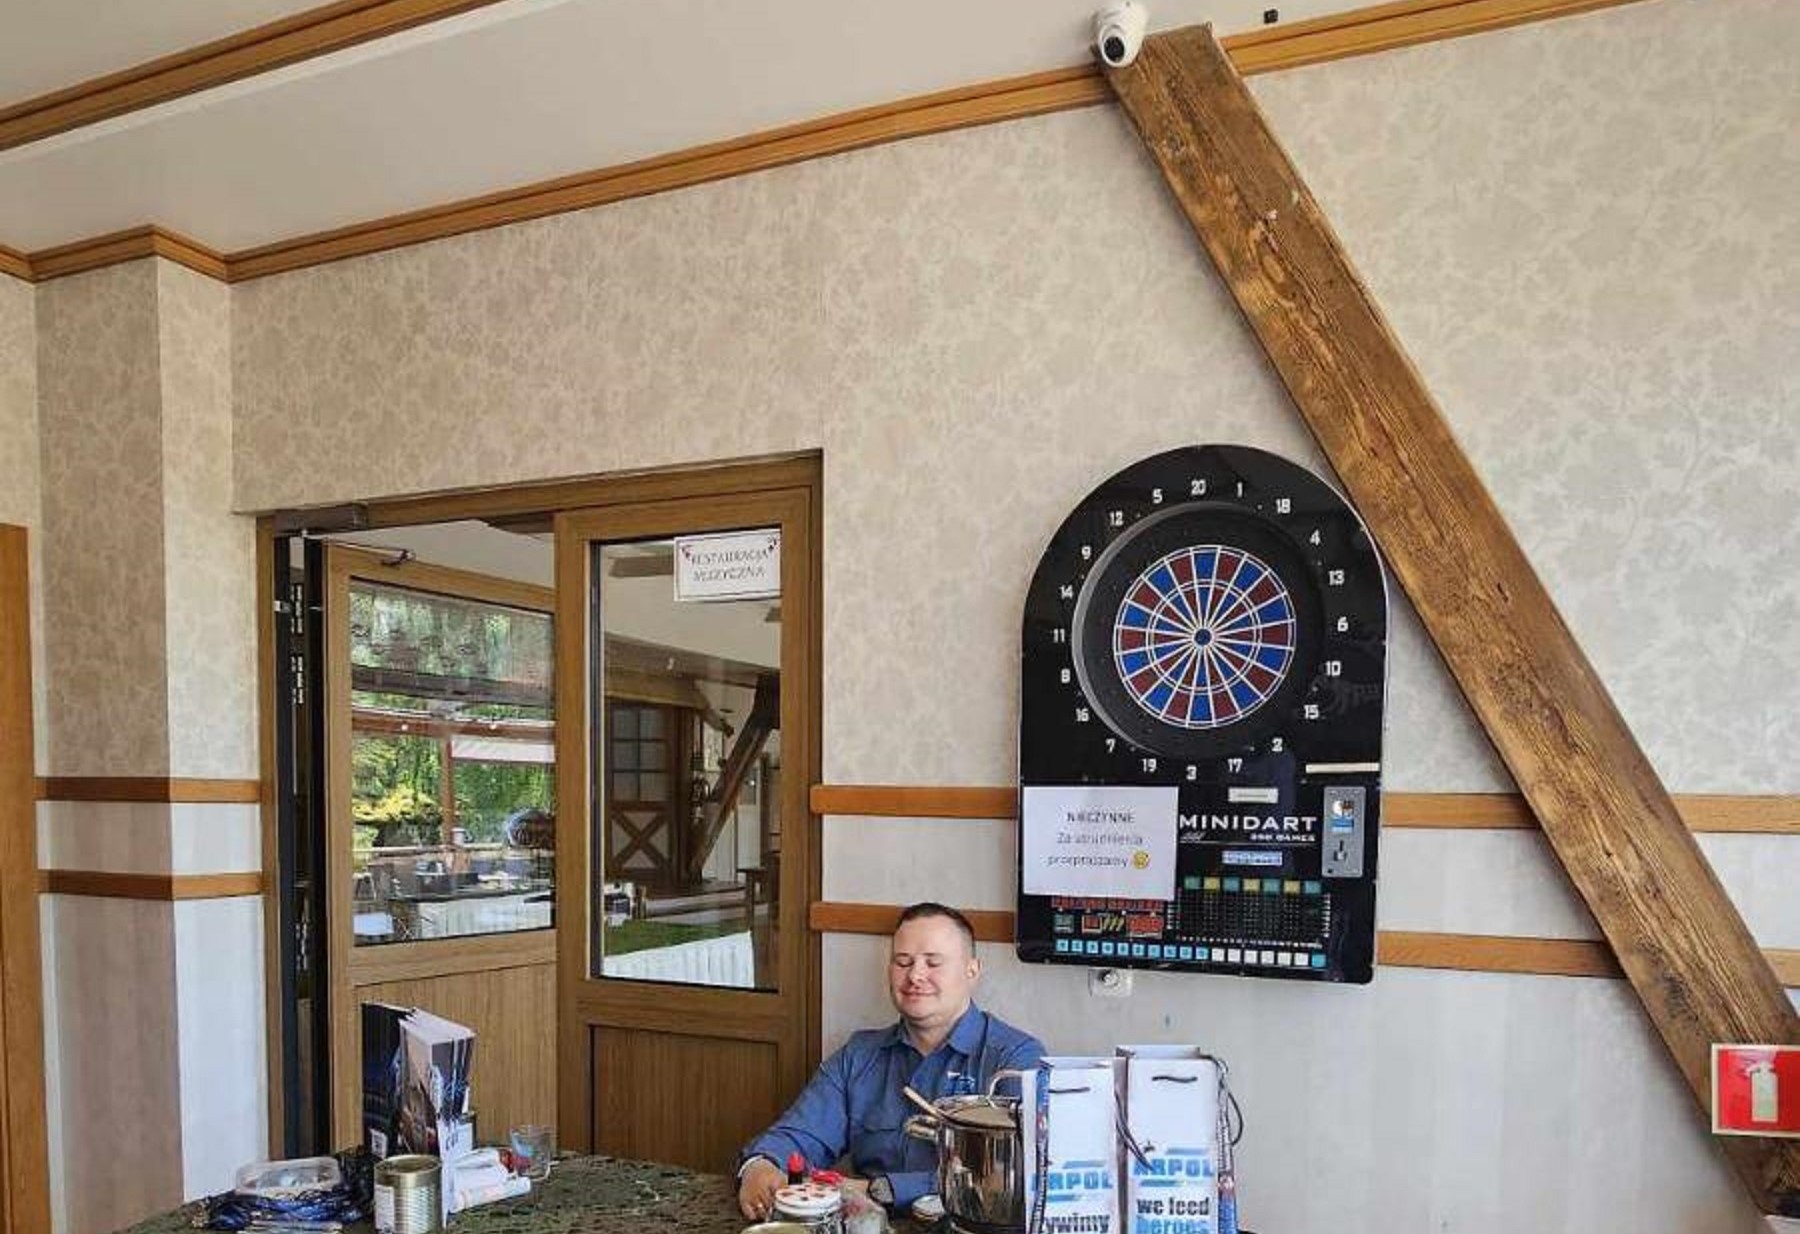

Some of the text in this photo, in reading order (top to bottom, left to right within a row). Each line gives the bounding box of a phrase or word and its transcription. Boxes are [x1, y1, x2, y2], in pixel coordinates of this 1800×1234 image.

[1190, 479, 1207, 495] 20
[1236, 482, 1244, 497] 1
[1152, 488, 1163, 504] 5
[1275, 498, 1291, 514] 18
[1109, 510, 1124, 526] 12
[1309, 530, 1321, 545] 4
[1081, 545, 1092, 560] 9
[1328, 570, 1345, 585] 13
[1060, 584, 1074, 600] 14
[1337, 616, 1349, 632] 6
[1053, 628, 1065, 643] 11
[1325, 660, 1342, 677] 10
[1075, 707, 1090, 722] 16
[1303, 704, 1320, 720] 15
[1105, 738, 1116, 753] 7
[1271, 737, 1283, 753] 2
[1142, 758, 1157, 773] 19
[1186, 765, 1197, 781] 3
[1227, 757, 1243, 773] 17
[1179, 814, 1317, 831] MINIDART
[1136, 1197, 1209, 1216] we feed
[1040, 1212, 1110, 1234] ywimy
